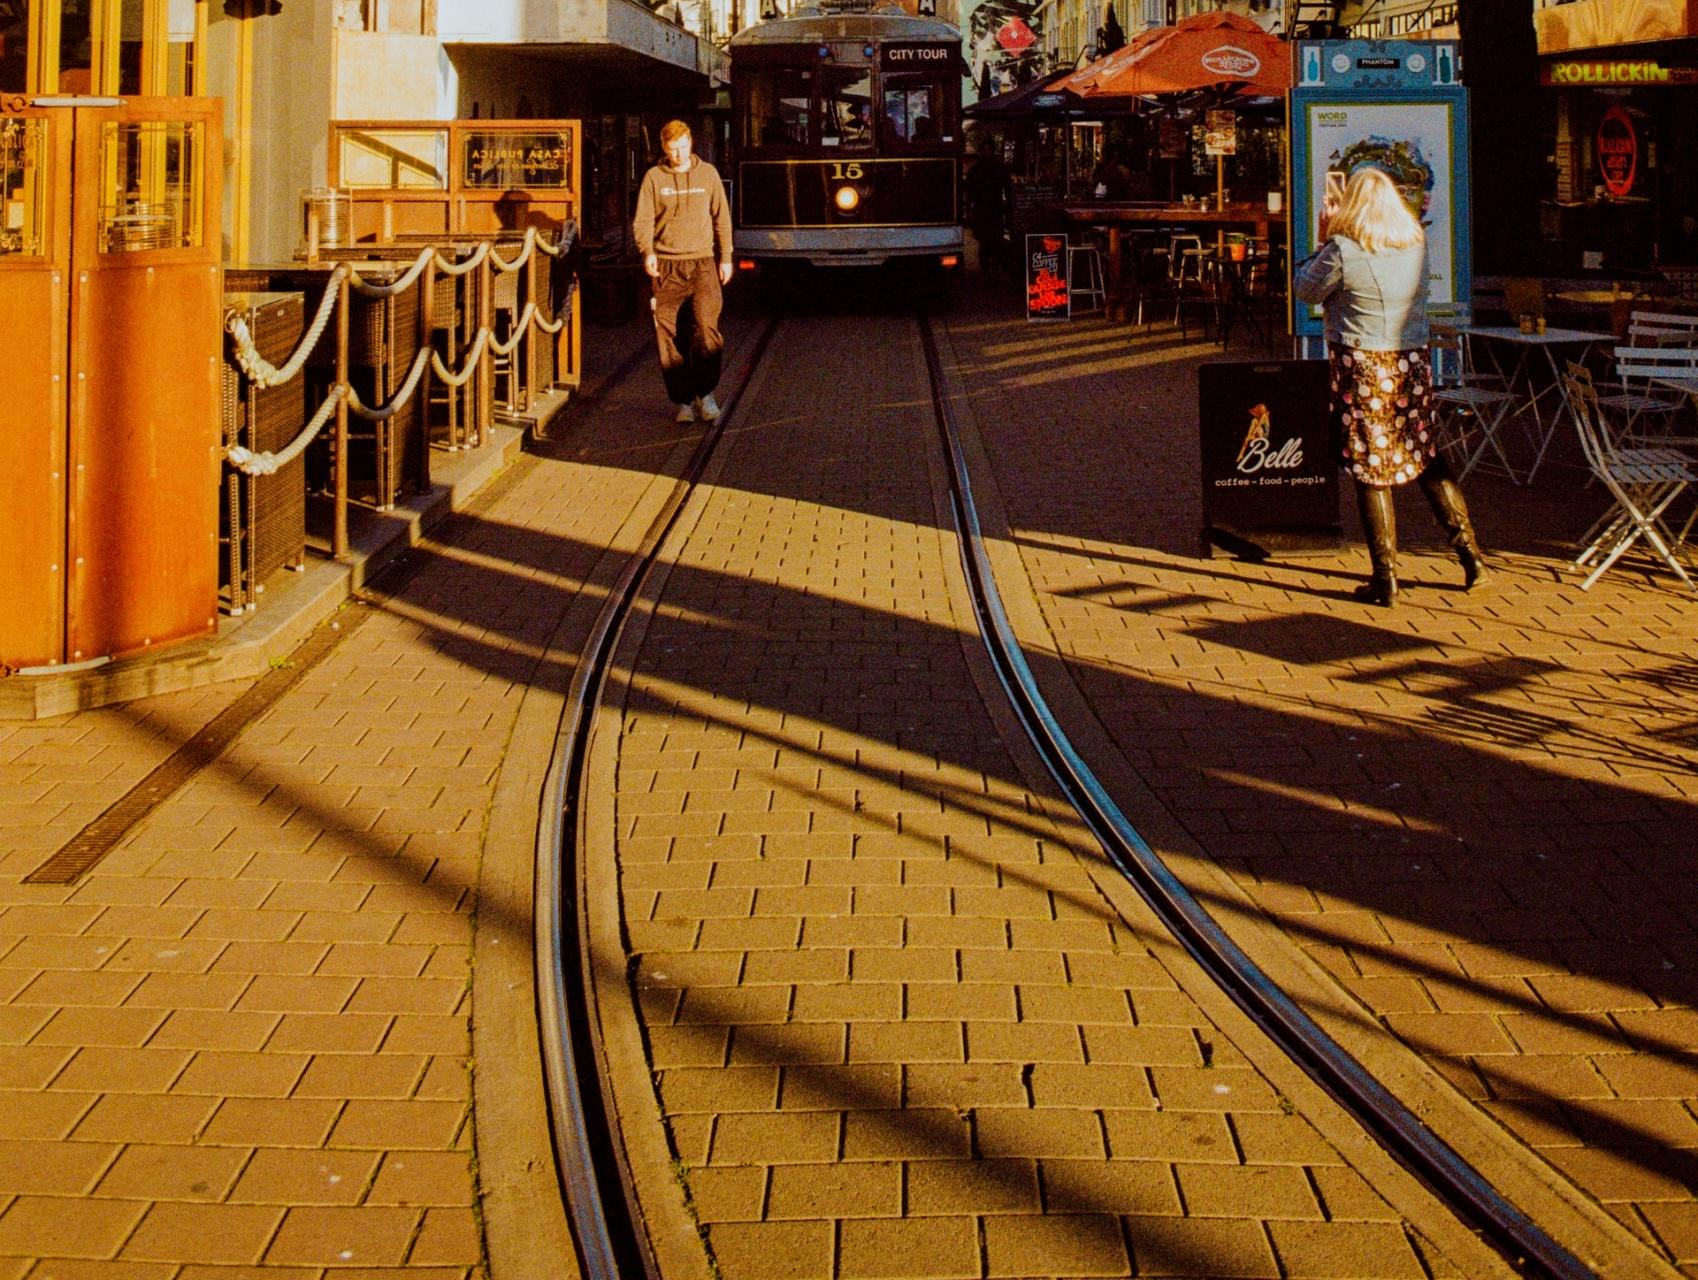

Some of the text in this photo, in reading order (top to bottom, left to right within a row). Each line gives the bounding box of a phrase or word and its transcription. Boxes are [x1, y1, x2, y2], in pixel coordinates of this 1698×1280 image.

[889, 49, 947, 60] CITY TOUR
[1317, 112, 1348, 120] WORD
[832, 163, 863, 179] 15
[1237, 437, 1303, 473] Belle
[1215, 478, 1250, 486] coffee
[1259, 476, 1282, 485] food
[1291, 476, 1326, 486] people
